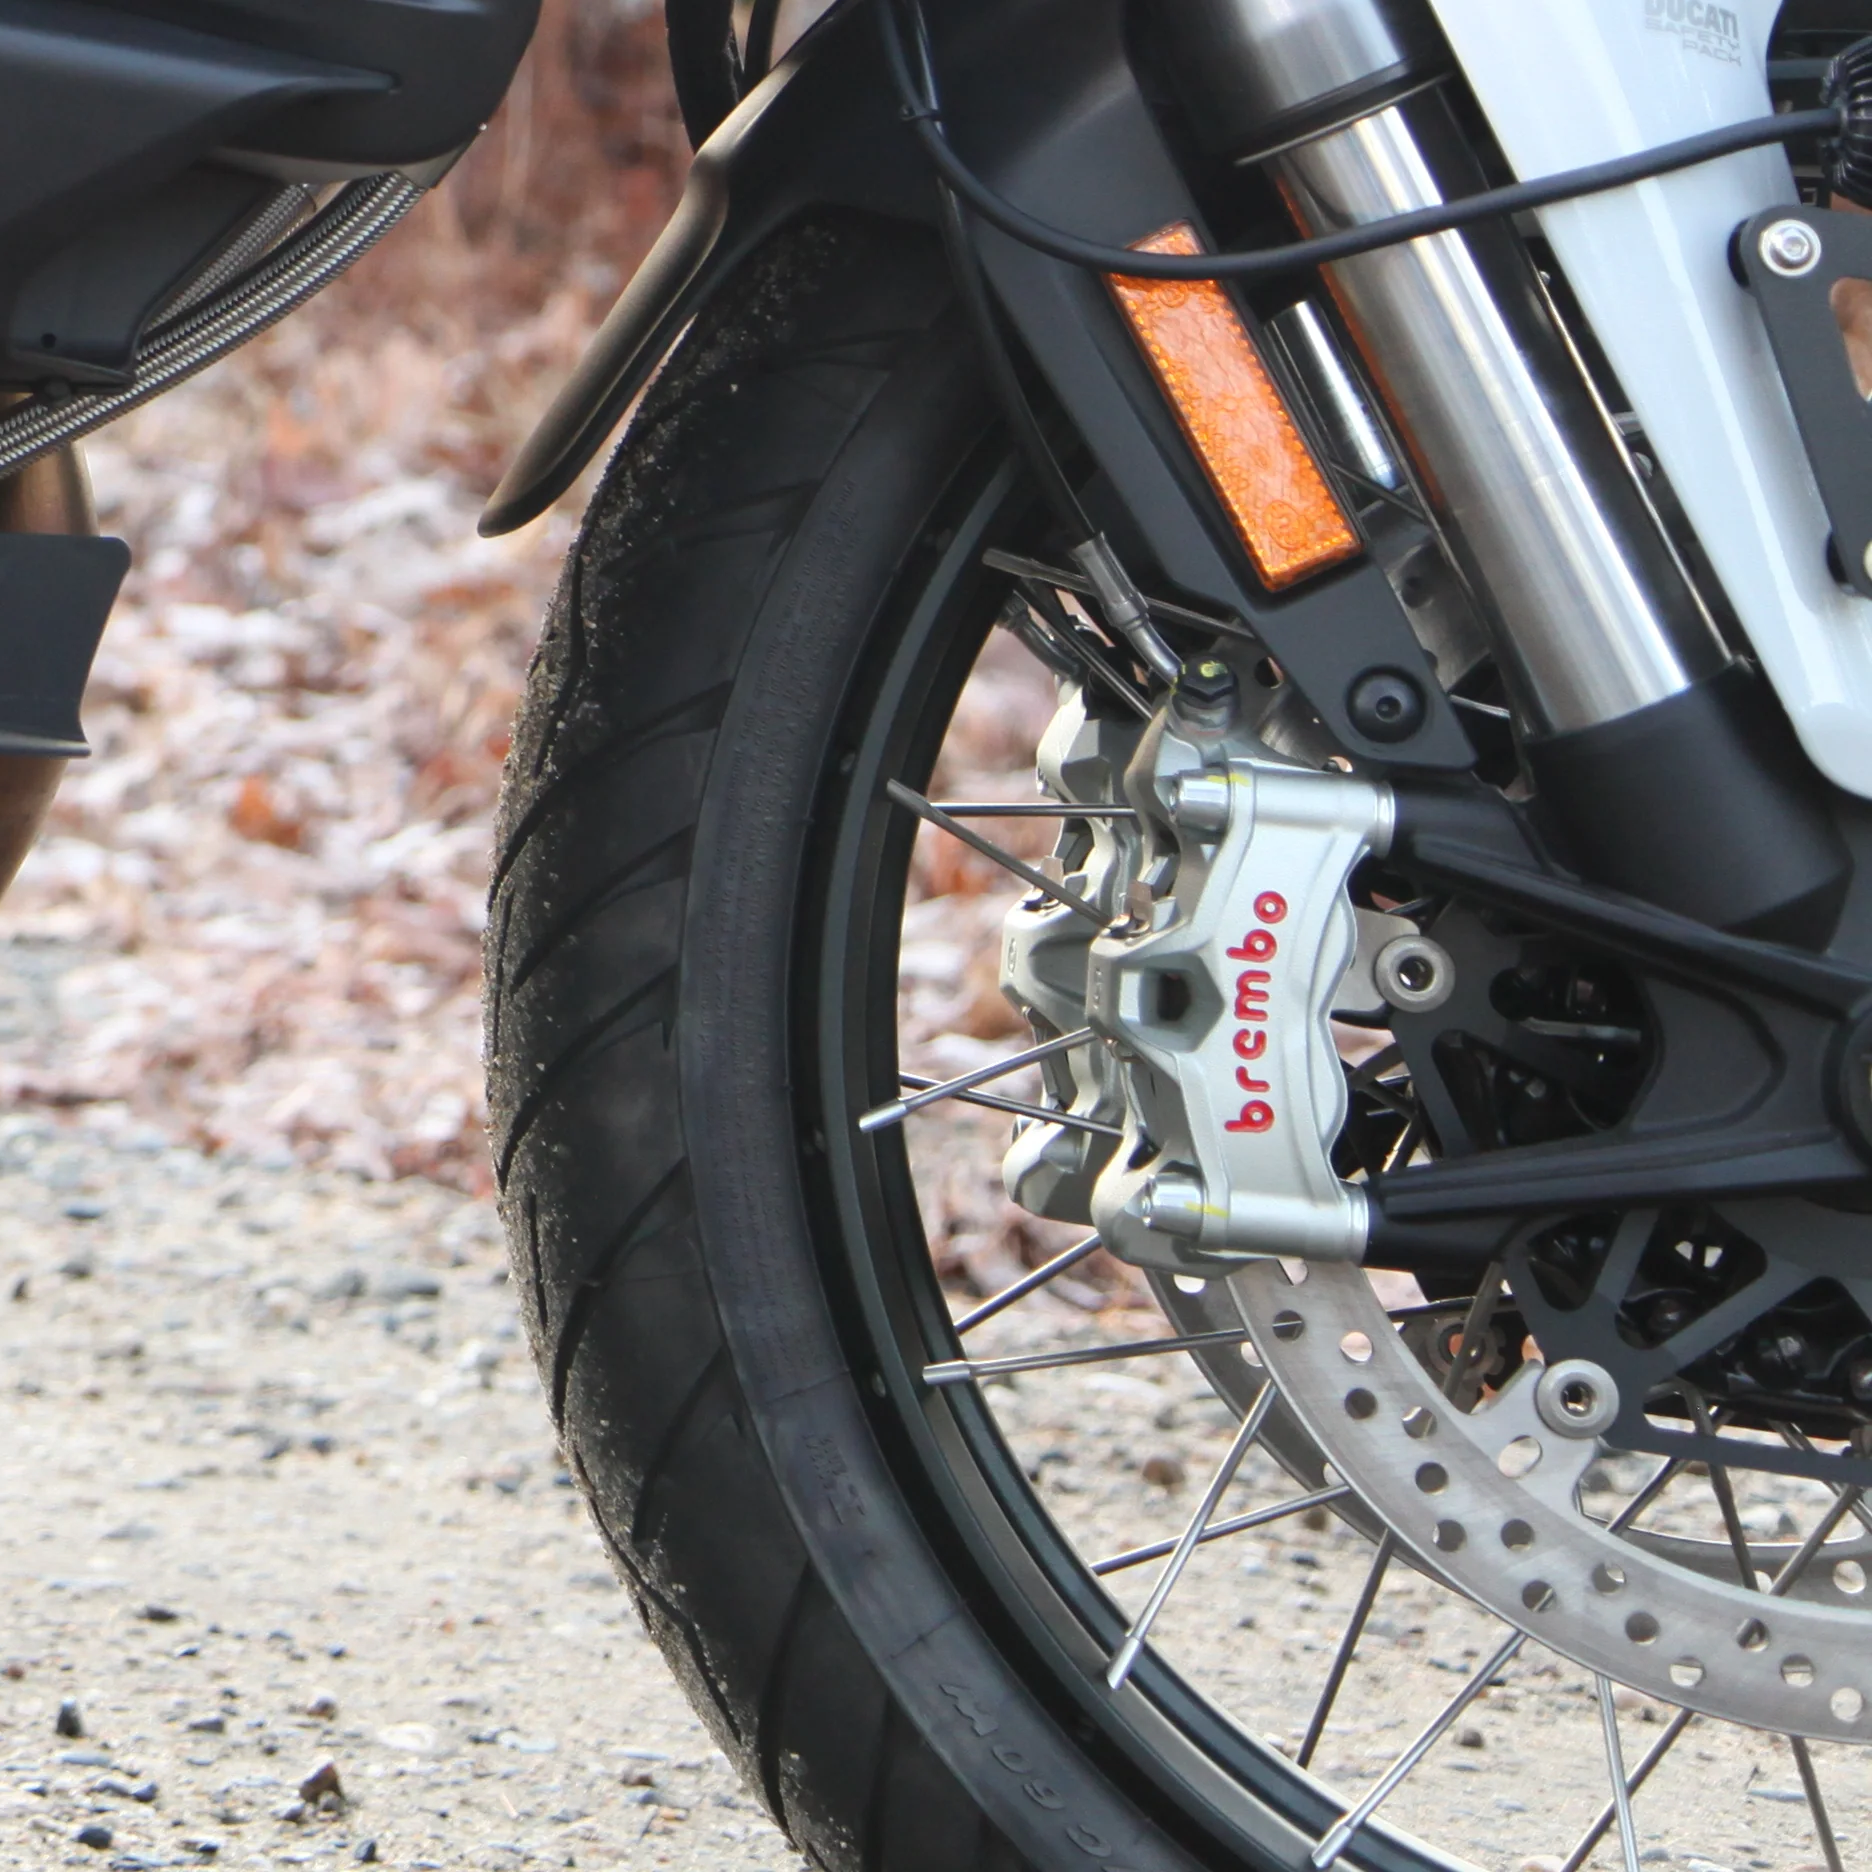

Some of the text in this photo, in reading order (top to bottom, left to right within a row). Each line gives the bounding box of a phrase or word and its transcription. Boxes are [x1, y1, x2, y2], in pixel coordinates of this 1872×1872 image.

[1644, 16, 1741, 51] SAFETY
[1682, 39, 1742, 67] PACK
[1223, 890, 1289, 1134] brembo
